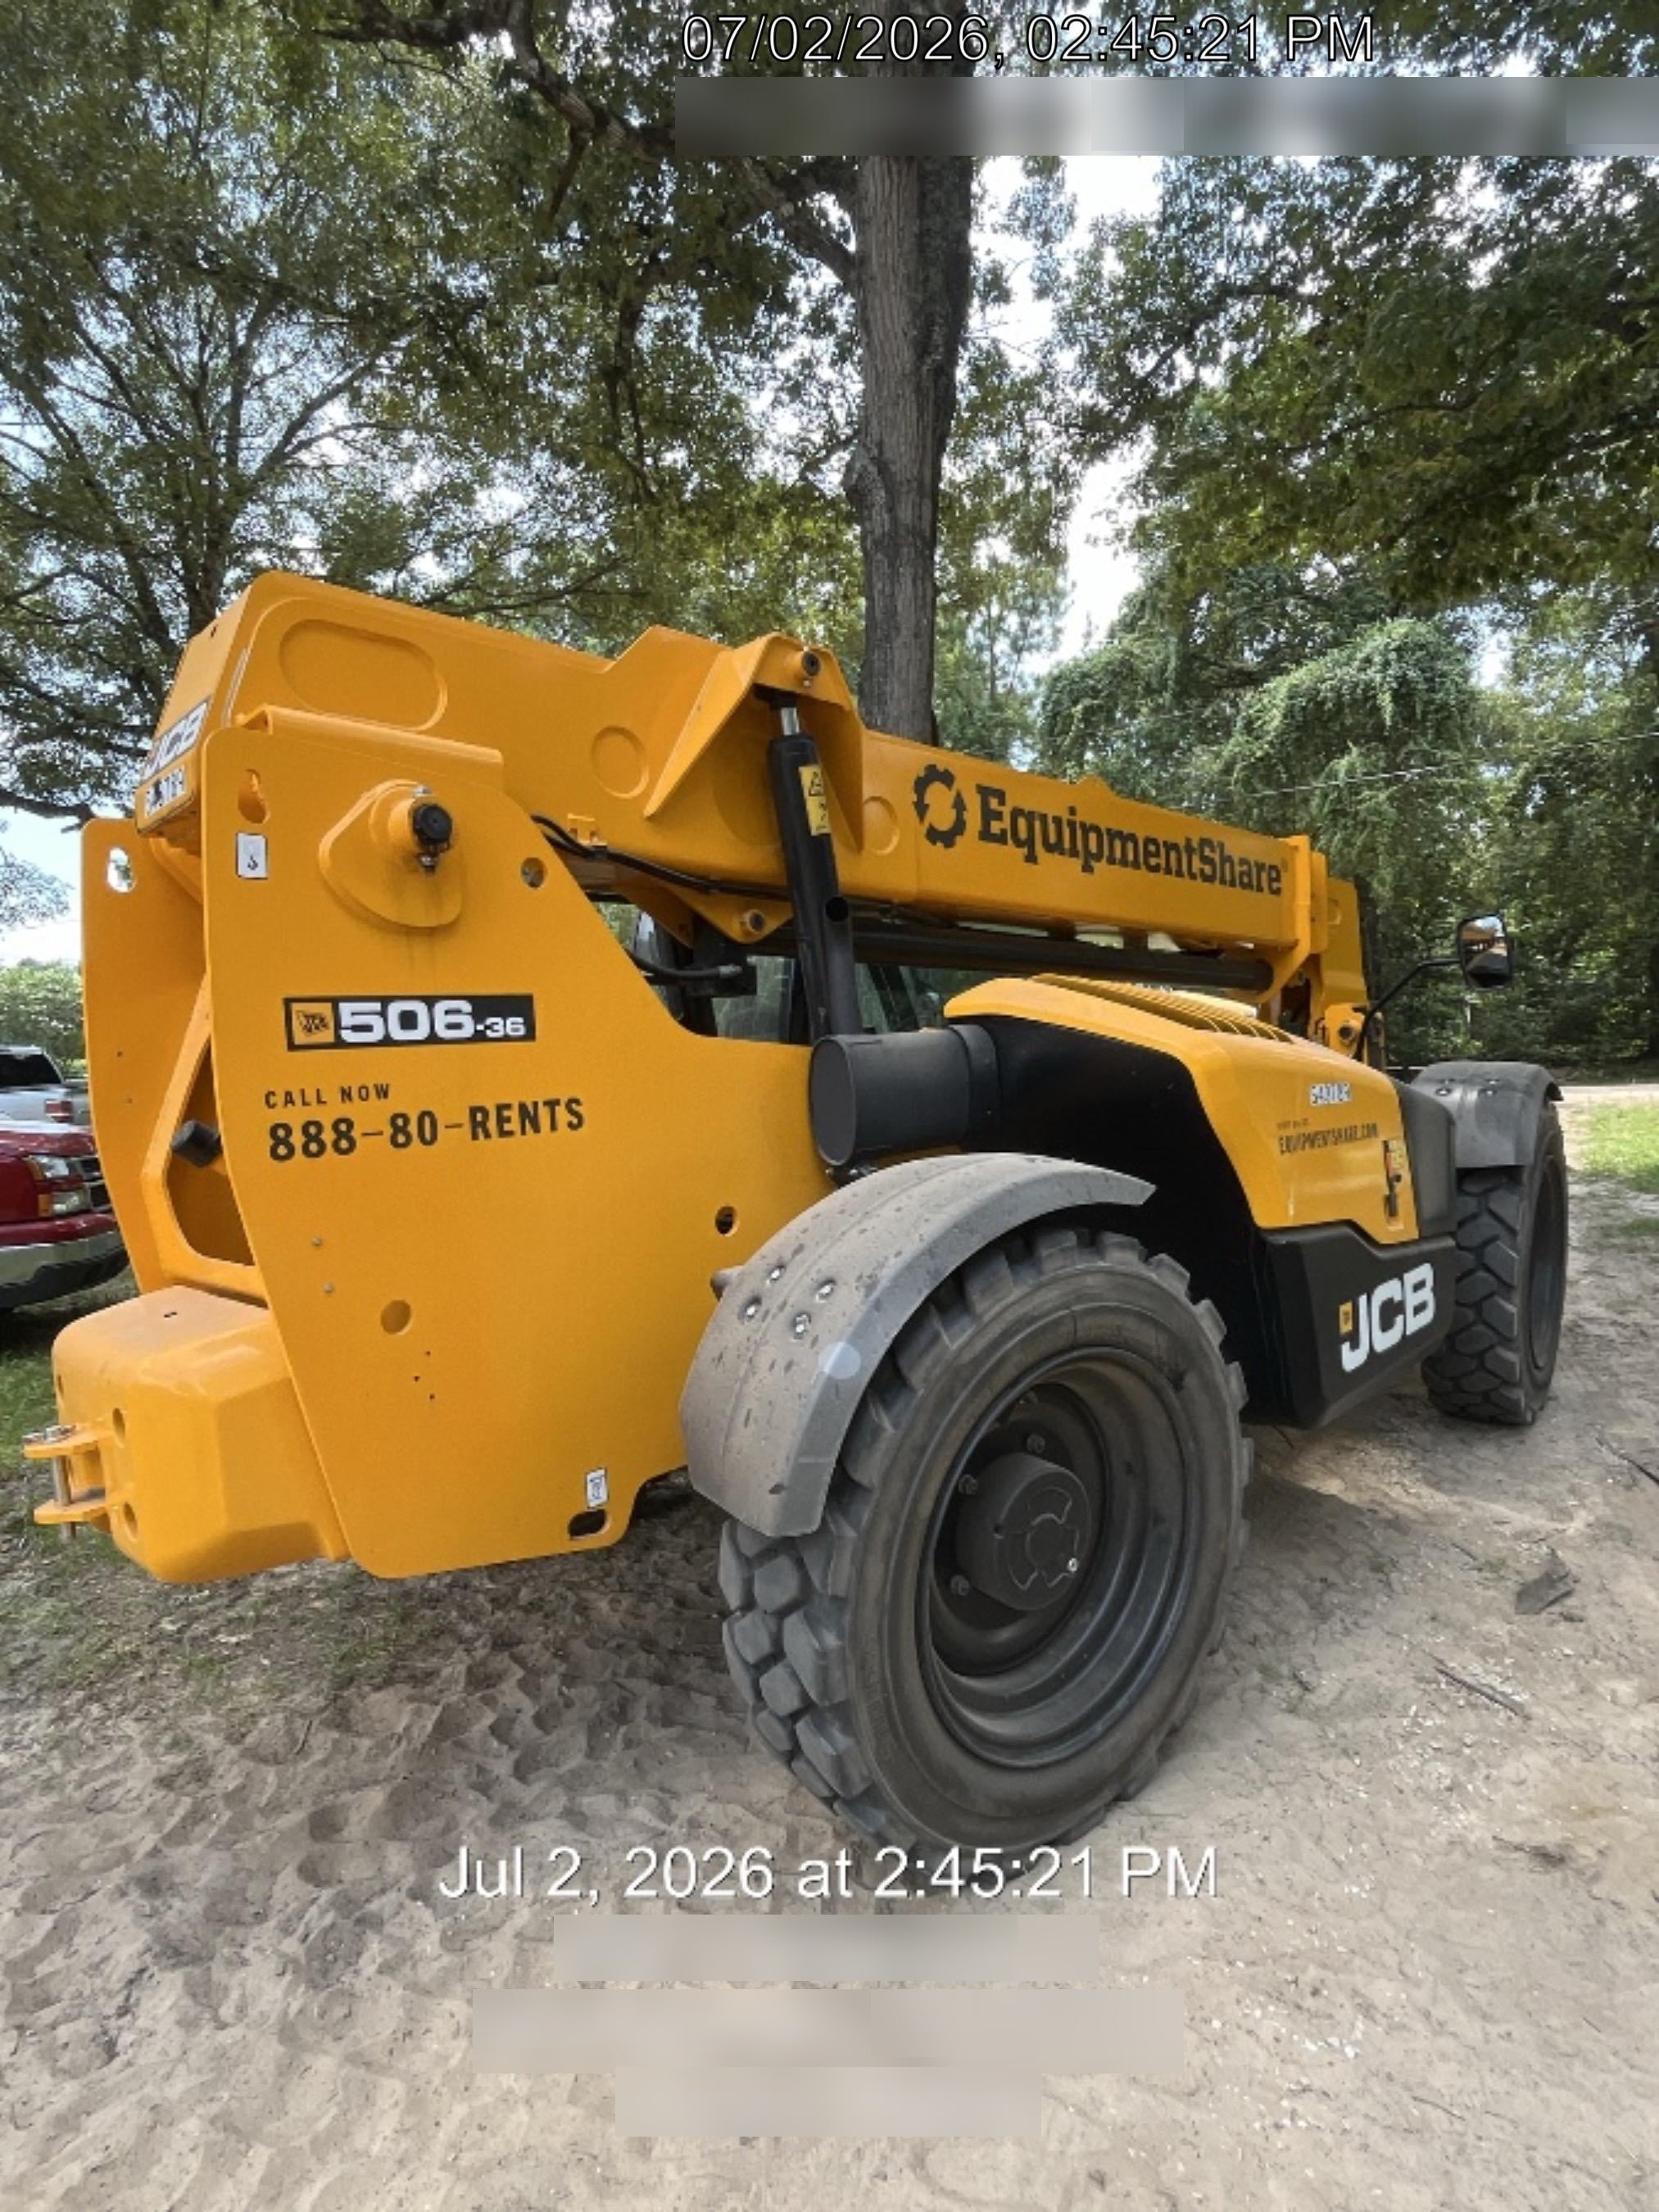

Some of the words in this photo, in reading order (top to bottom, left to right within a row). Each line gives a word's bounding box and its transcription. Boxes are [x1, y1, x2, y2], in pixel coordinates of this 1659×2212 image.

[975, 783, 1282, 896] EquipmentShare
[338, 999, 526, 1043] 506-36
[265, 1088, 327, 1108] CALL
[340, 1083, 391, 1103] NOW
[269, 1097, 585, 1163] 888-80-RENTS
[1341, 1262, 1436, 1372] JCB
